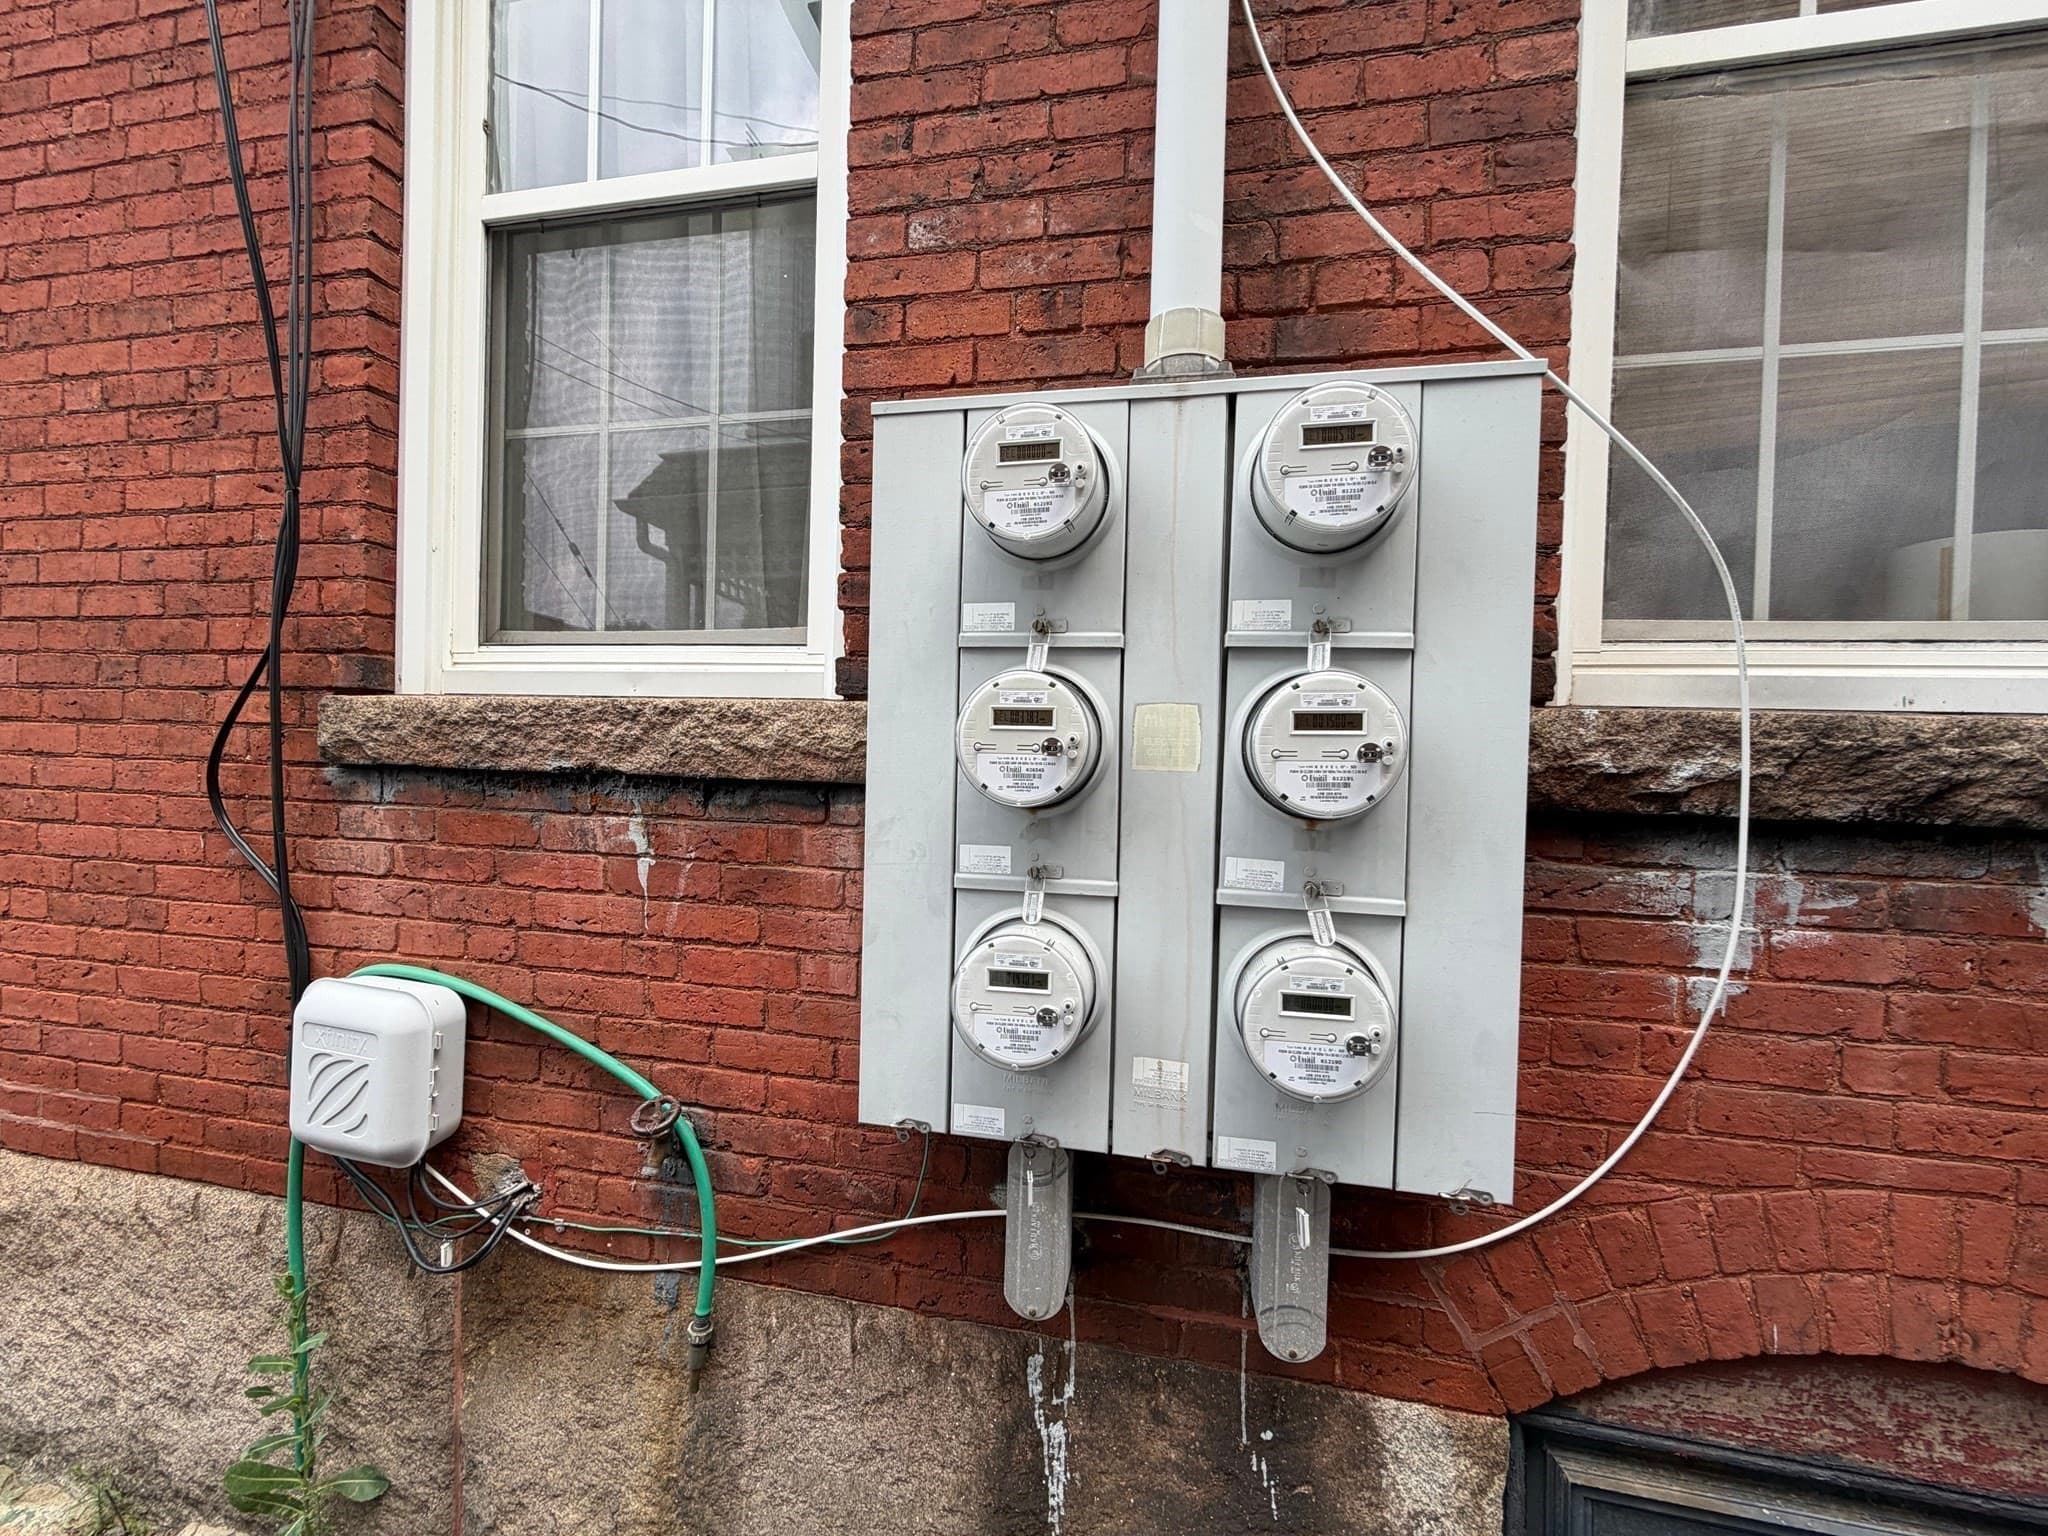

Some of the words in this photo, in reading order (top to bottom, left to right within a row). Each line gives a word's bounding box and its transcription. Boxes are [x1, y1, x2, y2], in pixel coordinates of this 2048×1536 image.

[1318, 488, 1337, 496] Unitil
[1006, 765, 1022, 773] Unitil
[1309, 774, 1328, 782] Unitil
